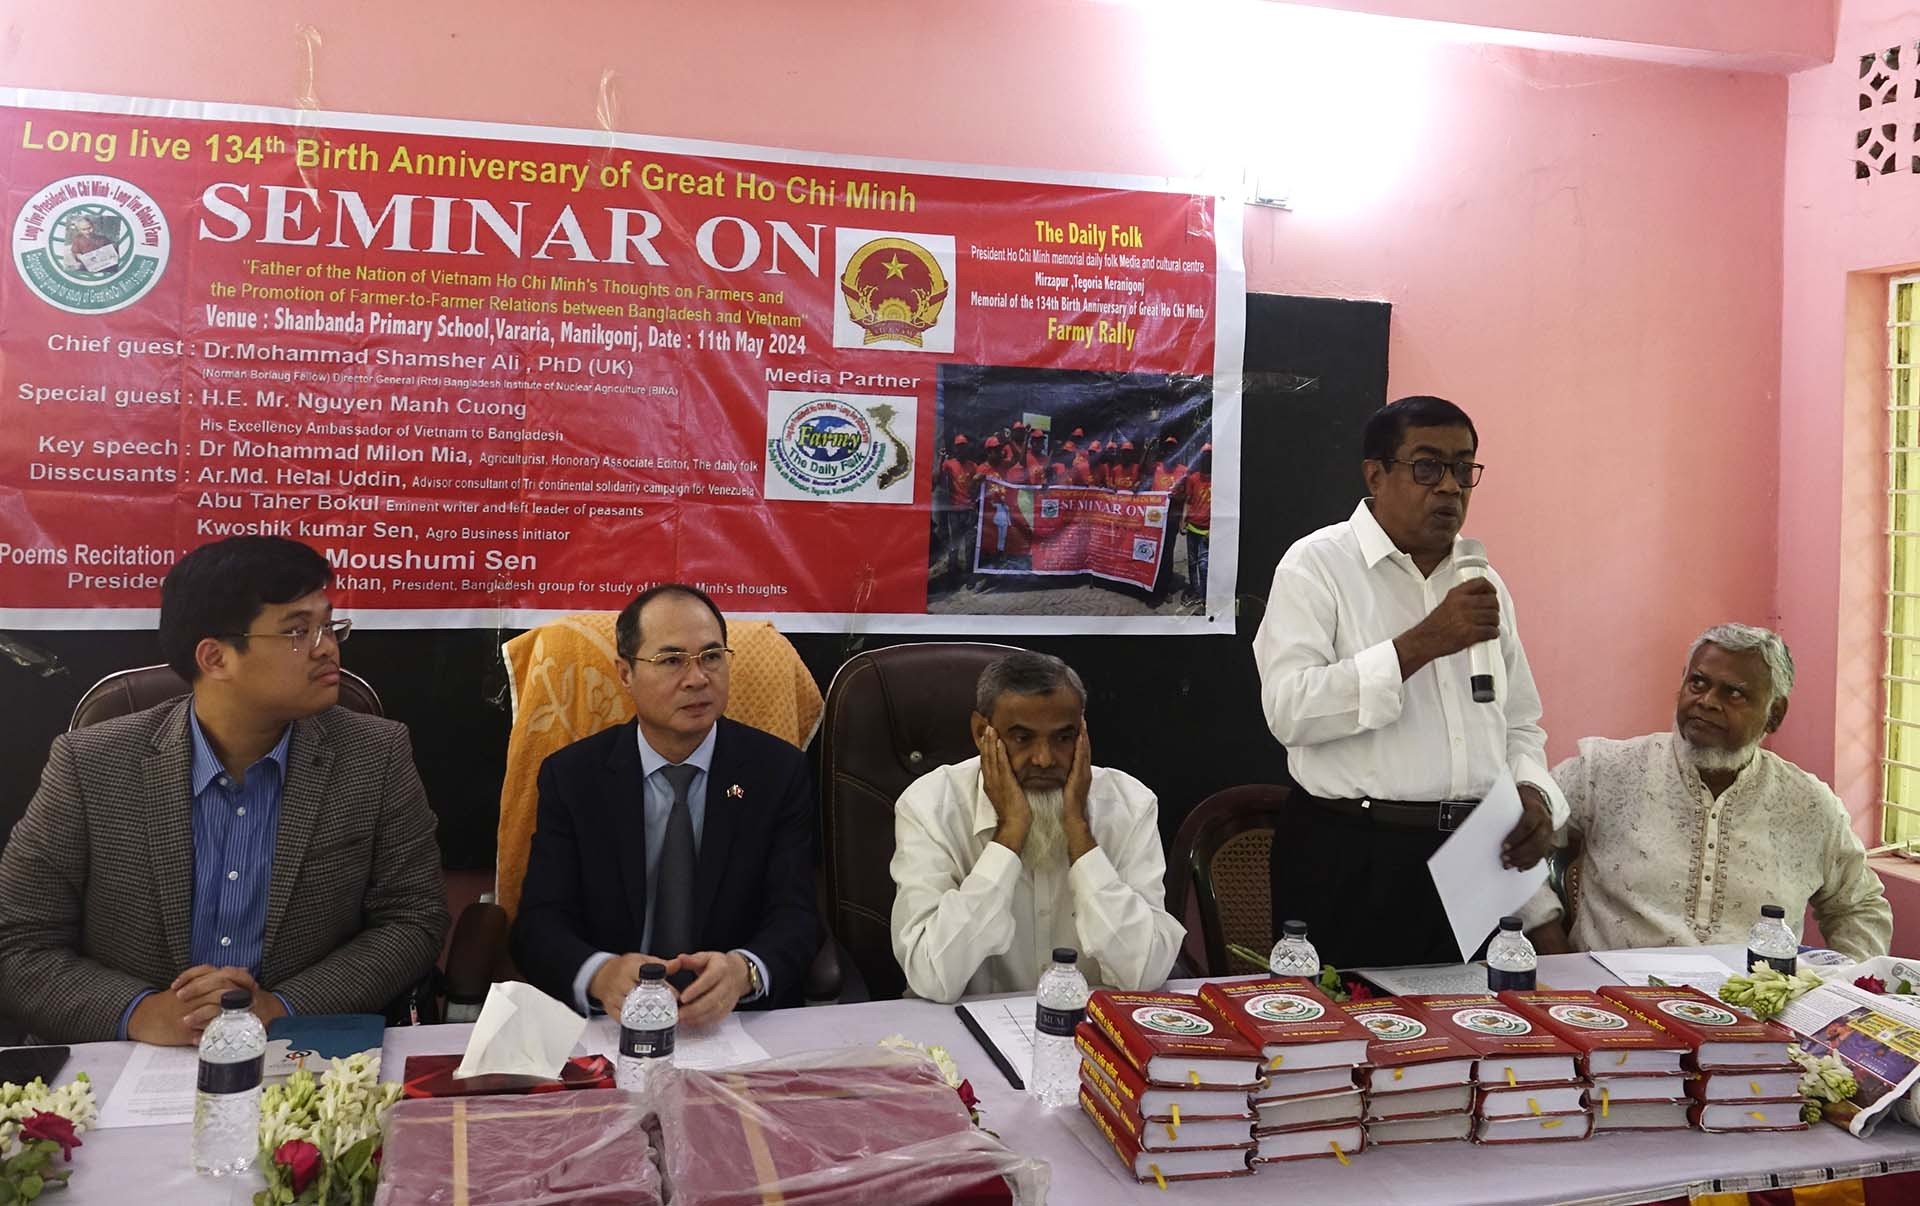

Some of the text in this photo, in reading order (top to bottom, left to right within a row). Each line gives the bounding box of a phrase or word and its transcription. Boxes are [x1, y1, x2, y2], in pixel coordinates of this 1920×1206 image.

[23, 120, 117, 162] Long
[129, 129, 191, 160] live
[297, 139, 379, 172] Birth
[388, 146, 590, 192] Anniversary
[600, 160, 632, 188] of
[641, 163, 725, 197] Great
[736, 172, 775, 201] Ho
[787, 176, 835, 206] Chi
[846, 182, 916, 213] Minh
[199, 182, 827, 278] SEMINAR ON
[1035, 221, 1143, 251] The Daily Folk
[971, 245, 1205, 273] President Ho Minh memorial daily folk Media and cultural centre
[306, 262, 323, 279] of
[327, 262, 351, 279] the
[356, 266, 406, 283] Nation
[410, 268, 427, 284] of
[431, 270, 491, 288] Vietnam
[497, 273, 517, 289] Ho
[521, 274, 547, 290] Chi
[551, 276, 598, 293] Minh's
[604, 279, 669, 298] Thoughts
[675, 285, 692, 299] on
[697, 285, 754, 302] Farmers
[758, 289, 784, 304] and
[1035, 272, 1069, 289] Mirzapur
[1104, 276, 1145, 296] Keranigonj
[210, 281, 236, 297] the
[241, 283, 325, 302] Promotion
[330, 286, 346, 302] of
[350, 290, 484, 310] Farmer-to-Farmer
[490, 296, 558, 314] Relations
[563, 299, 624, 317] between
[629, 303, 712, 324] Bangladesh
[716, 308, 742, 324] and
[970, 291, 1159, 318] Memorial of the 134th Birth Anniversary Great
[206, 304, 257, 329] Venue
[274, 307, 364, 333] Shanbanda
[370, 312, 432, 342] Primary
[560, 321, 643, 352] Manikgonj,
[649, 326, 681, 348] Date
[699, 331, 730, 350] 11th
[735, 334, 763, 359] May
[770, 335, 806, 355] 2024
[1048, 318, 1135, 351] Farmy Rally
[48, 334, 110, 353] Chief
[118, 337, 184, 358] guest
[375, 349, 485, 369] Shamsher
[491, 354, 519, 370] Ali
[539, 357, 581, 373] PhD
[589, 357, 633, 378] (UK)
[250, 370, 645, 395] Borlaug Director General Nuclear Agriculture
[765, 366, 920, 388] Media Partner
[18, 383, 527, 420] Special guest H.E. Mr. Nguyen Manh Cuong
[200, 419, 563, 442] His Excellency Ambassador of Vietnam Bangladesh
[797, 425, 862, 451] Farmy
[39, 436, 85, 457] Key
[93, 439, 178, 461] speech
[200, 440, 225, 457] Dr
[233, 440, 359, 460] Mohammad
[367, 444, 424, 462] Milon
[431, 447, 473, 466] Mia,
[552, 454, 599, 469] Honorary
[603, 456, 653, 469] Associate
[693, 459, 711, 471] The
[714, 460, 737, 473] daily
[789, 447, 807, 468] The
[810, 462, 838, 476] Daily
[841, 451, 865, 471] Folk
[30, 464, 177, 482] Disscusants
[277, 468, 331, 486] Helal
[339, 470, 406, 489] Uddin,
[412, 475, 451, 488] Advisor
[455, 477, 508, 489] consultant
[539, 480, 593, 491] continental
[596, 481, 641, 494] solidarity
[644, 484, 689, 497] campaign
[708, 484, 754, 496] Venezuela
[198, 492, 644, 519] Abu Taher Bokul Eminent writer and left leader peasants
[1061, 499, 1121, 516] SEMINAR
[197, 519, 570, 541] Kwoshik kumar Sen, Agro Business initiator
[0, 543, 175, 565] Poems Recitation
[325, 548, 536, 570] Moushumi Sen
[68, 572, 167, 588] Preside
[336, 574, 386, 593] khan,
[462, 580, 534, 593] Bangladesh
[539, 582, 574, 595] group
[599, 582, 632, 595] study
[737, 583, 788, 597] thoughts
